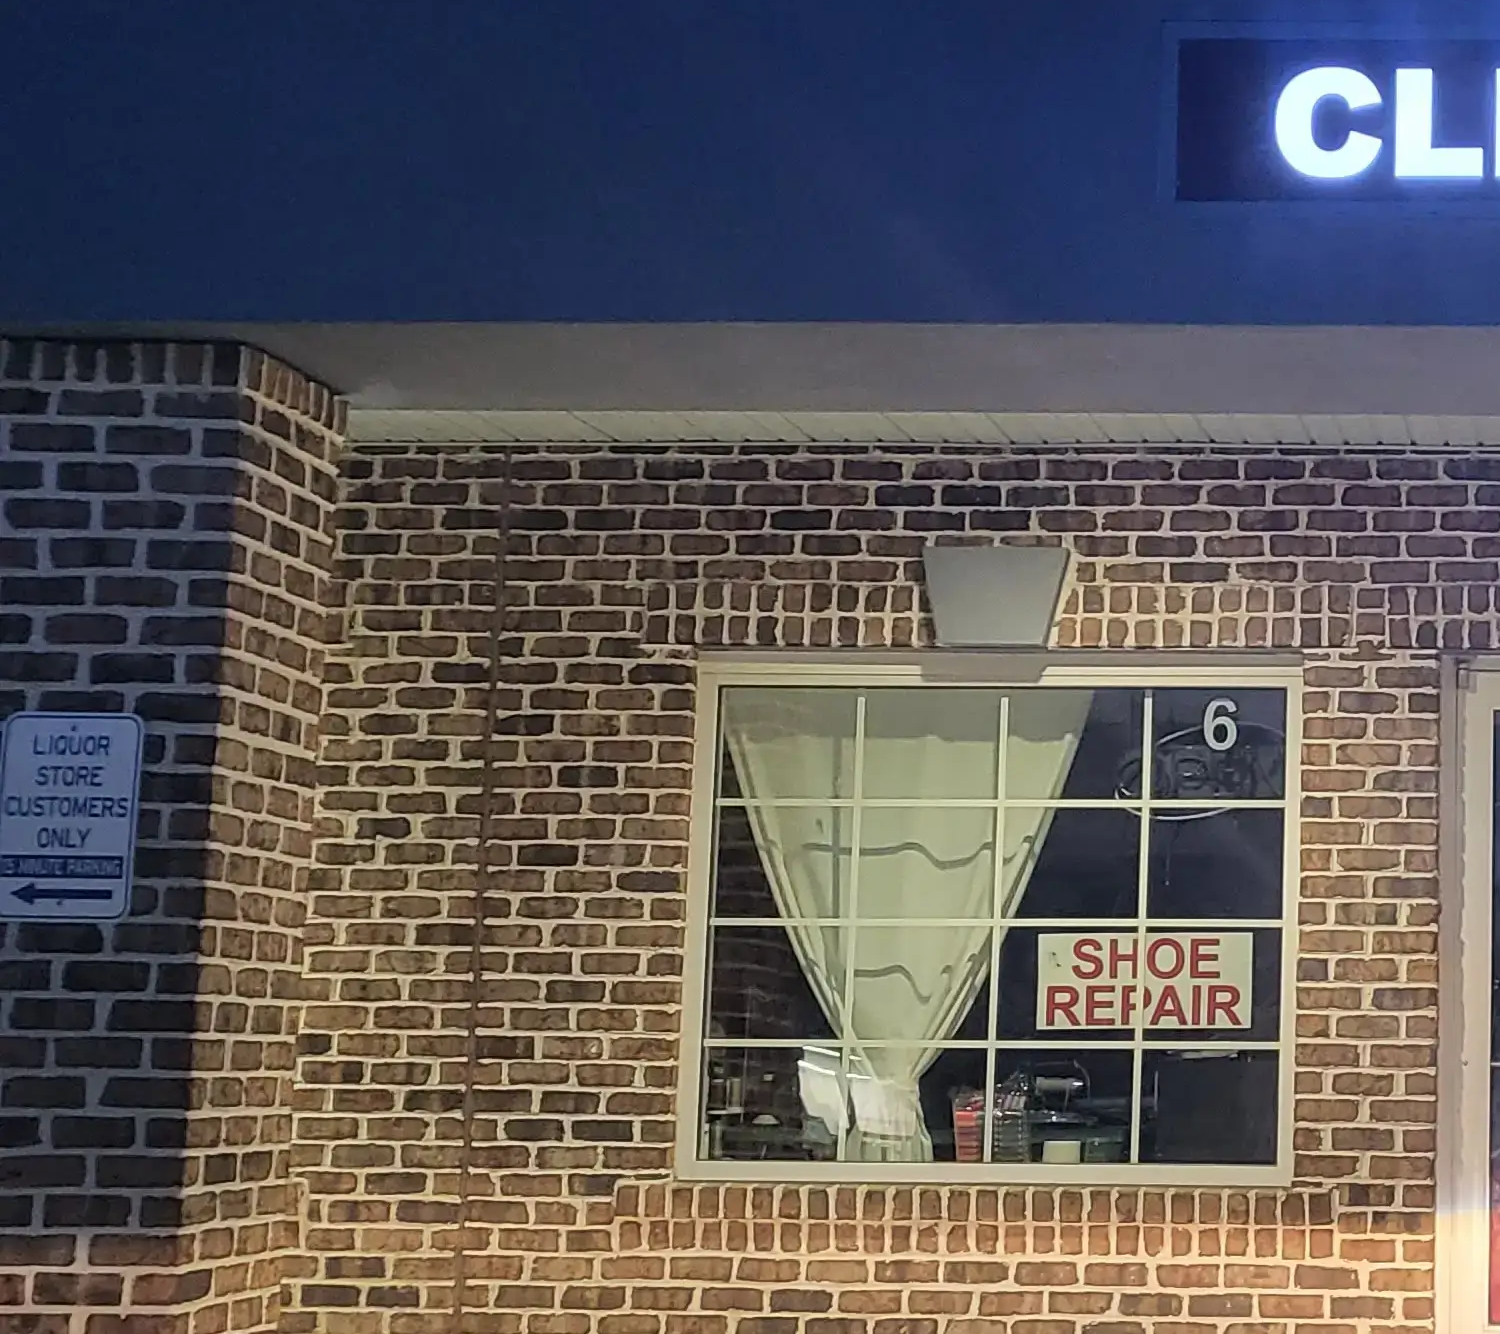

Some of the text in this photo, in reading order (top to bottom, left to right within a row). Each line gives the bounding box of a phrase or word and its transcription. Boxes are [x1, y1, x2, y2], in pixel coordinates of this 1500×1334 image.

[1203, 698, 1238, 751] 6
[33, 734, 110, 756] LIQUOR
[35, 766, 104, 787] STORE
[5, 796, 128, 818] CUSTOMERS
[37, 827, 92, 848] ONLY
[1071, 938, 1221, 980] SHOE
[1045, 984, 1243, 1027] REPAIR
